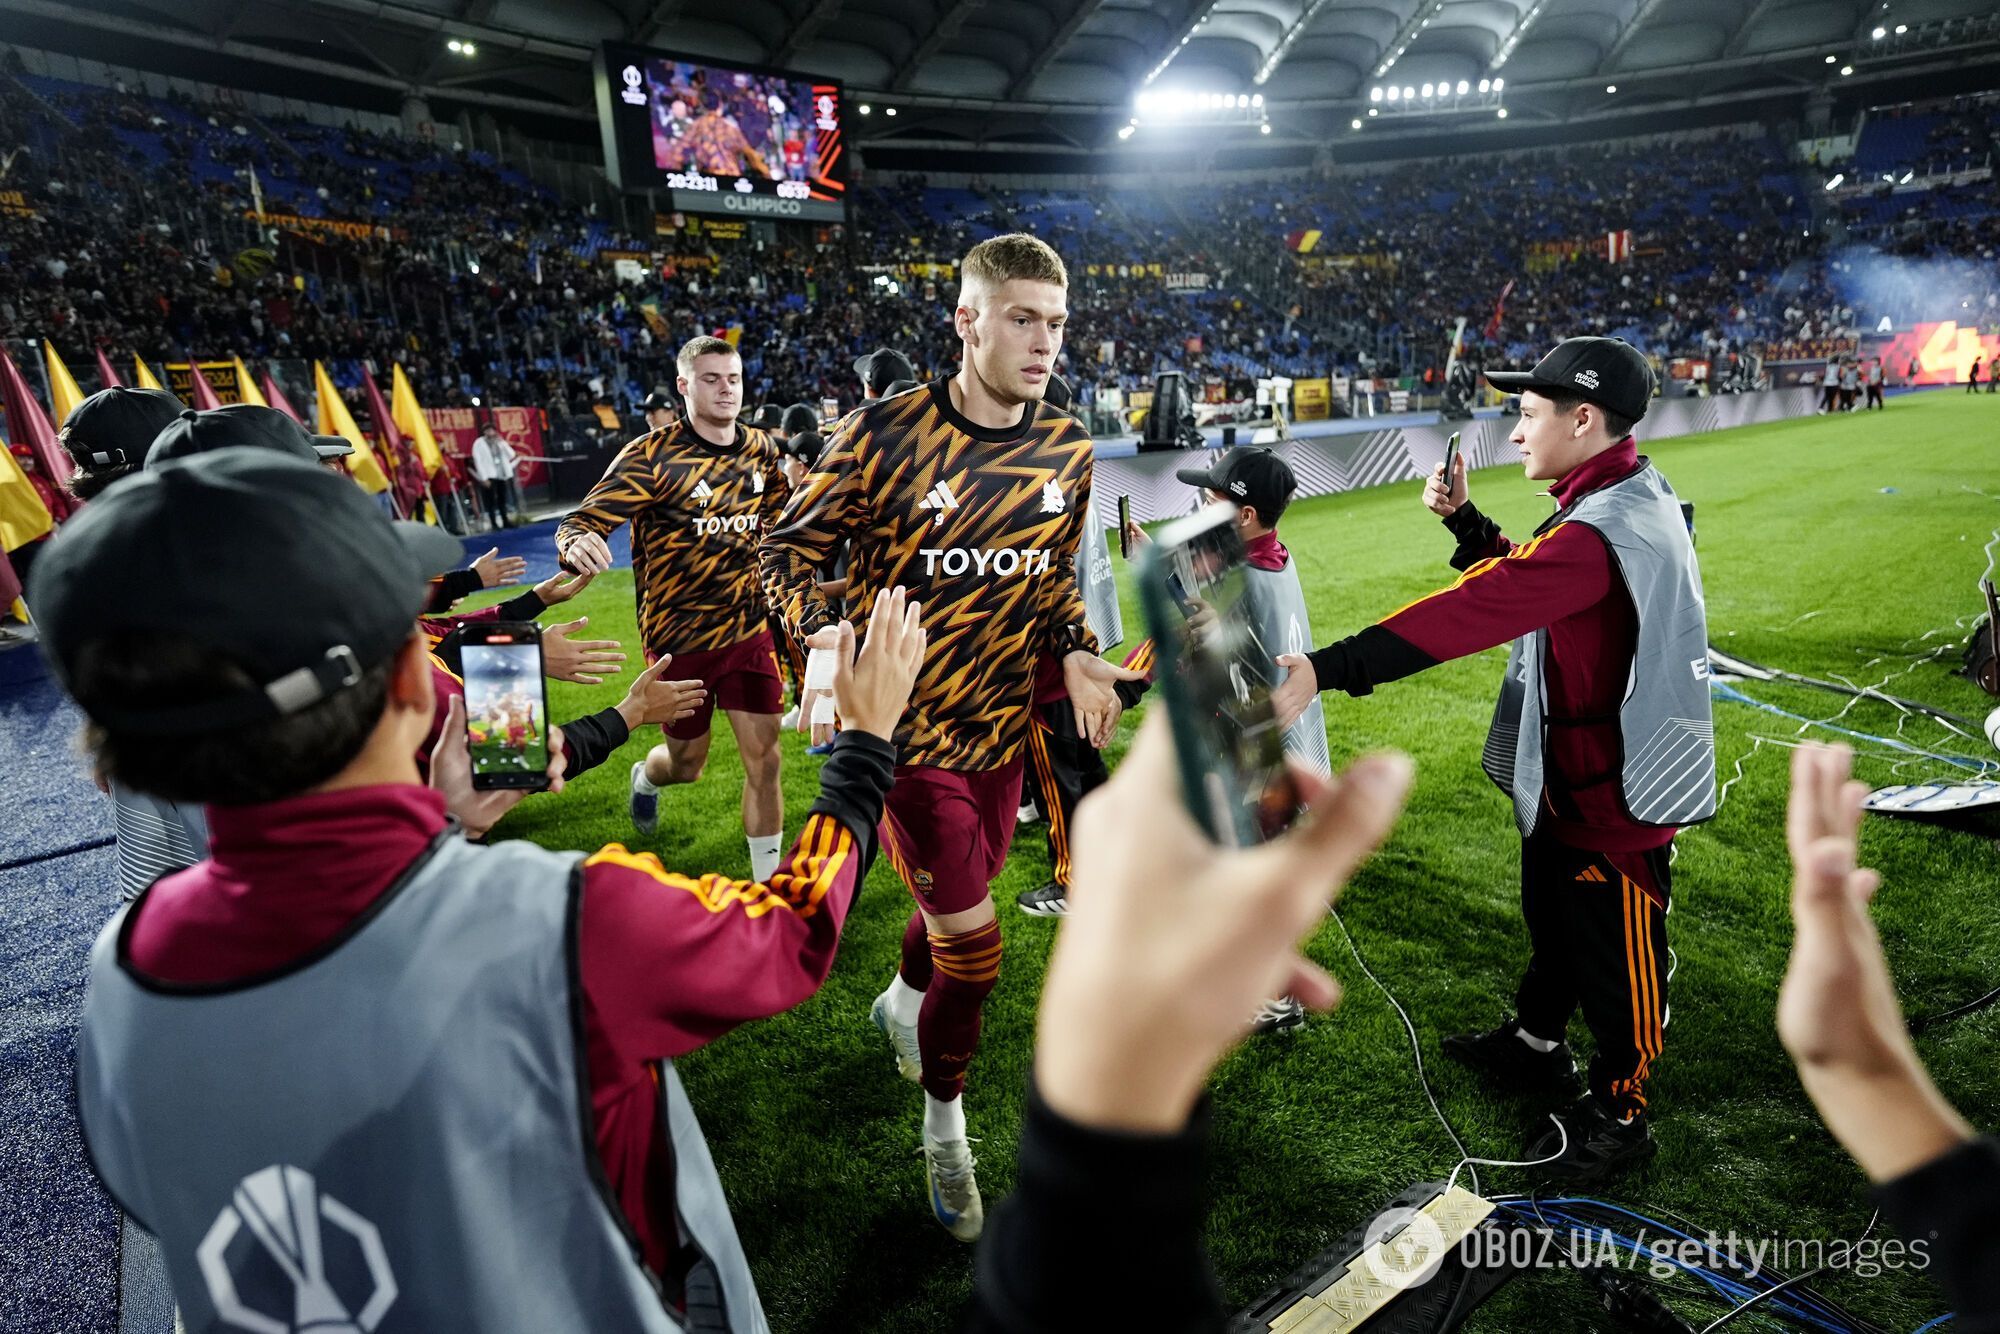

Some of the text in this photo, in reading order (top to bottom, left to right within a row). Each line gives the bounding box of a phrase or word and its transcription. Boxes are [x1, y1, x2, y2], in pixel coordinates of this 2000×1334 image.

[723, 195, 801, 214] OLIMPICO
[1574, 377, 1595, 389] LEAGUE
[1575, 372, 1600, 387] EUROPA
[934, 513, 945, 526] 9
[919, 548, 1051, 576] TOYOTA
